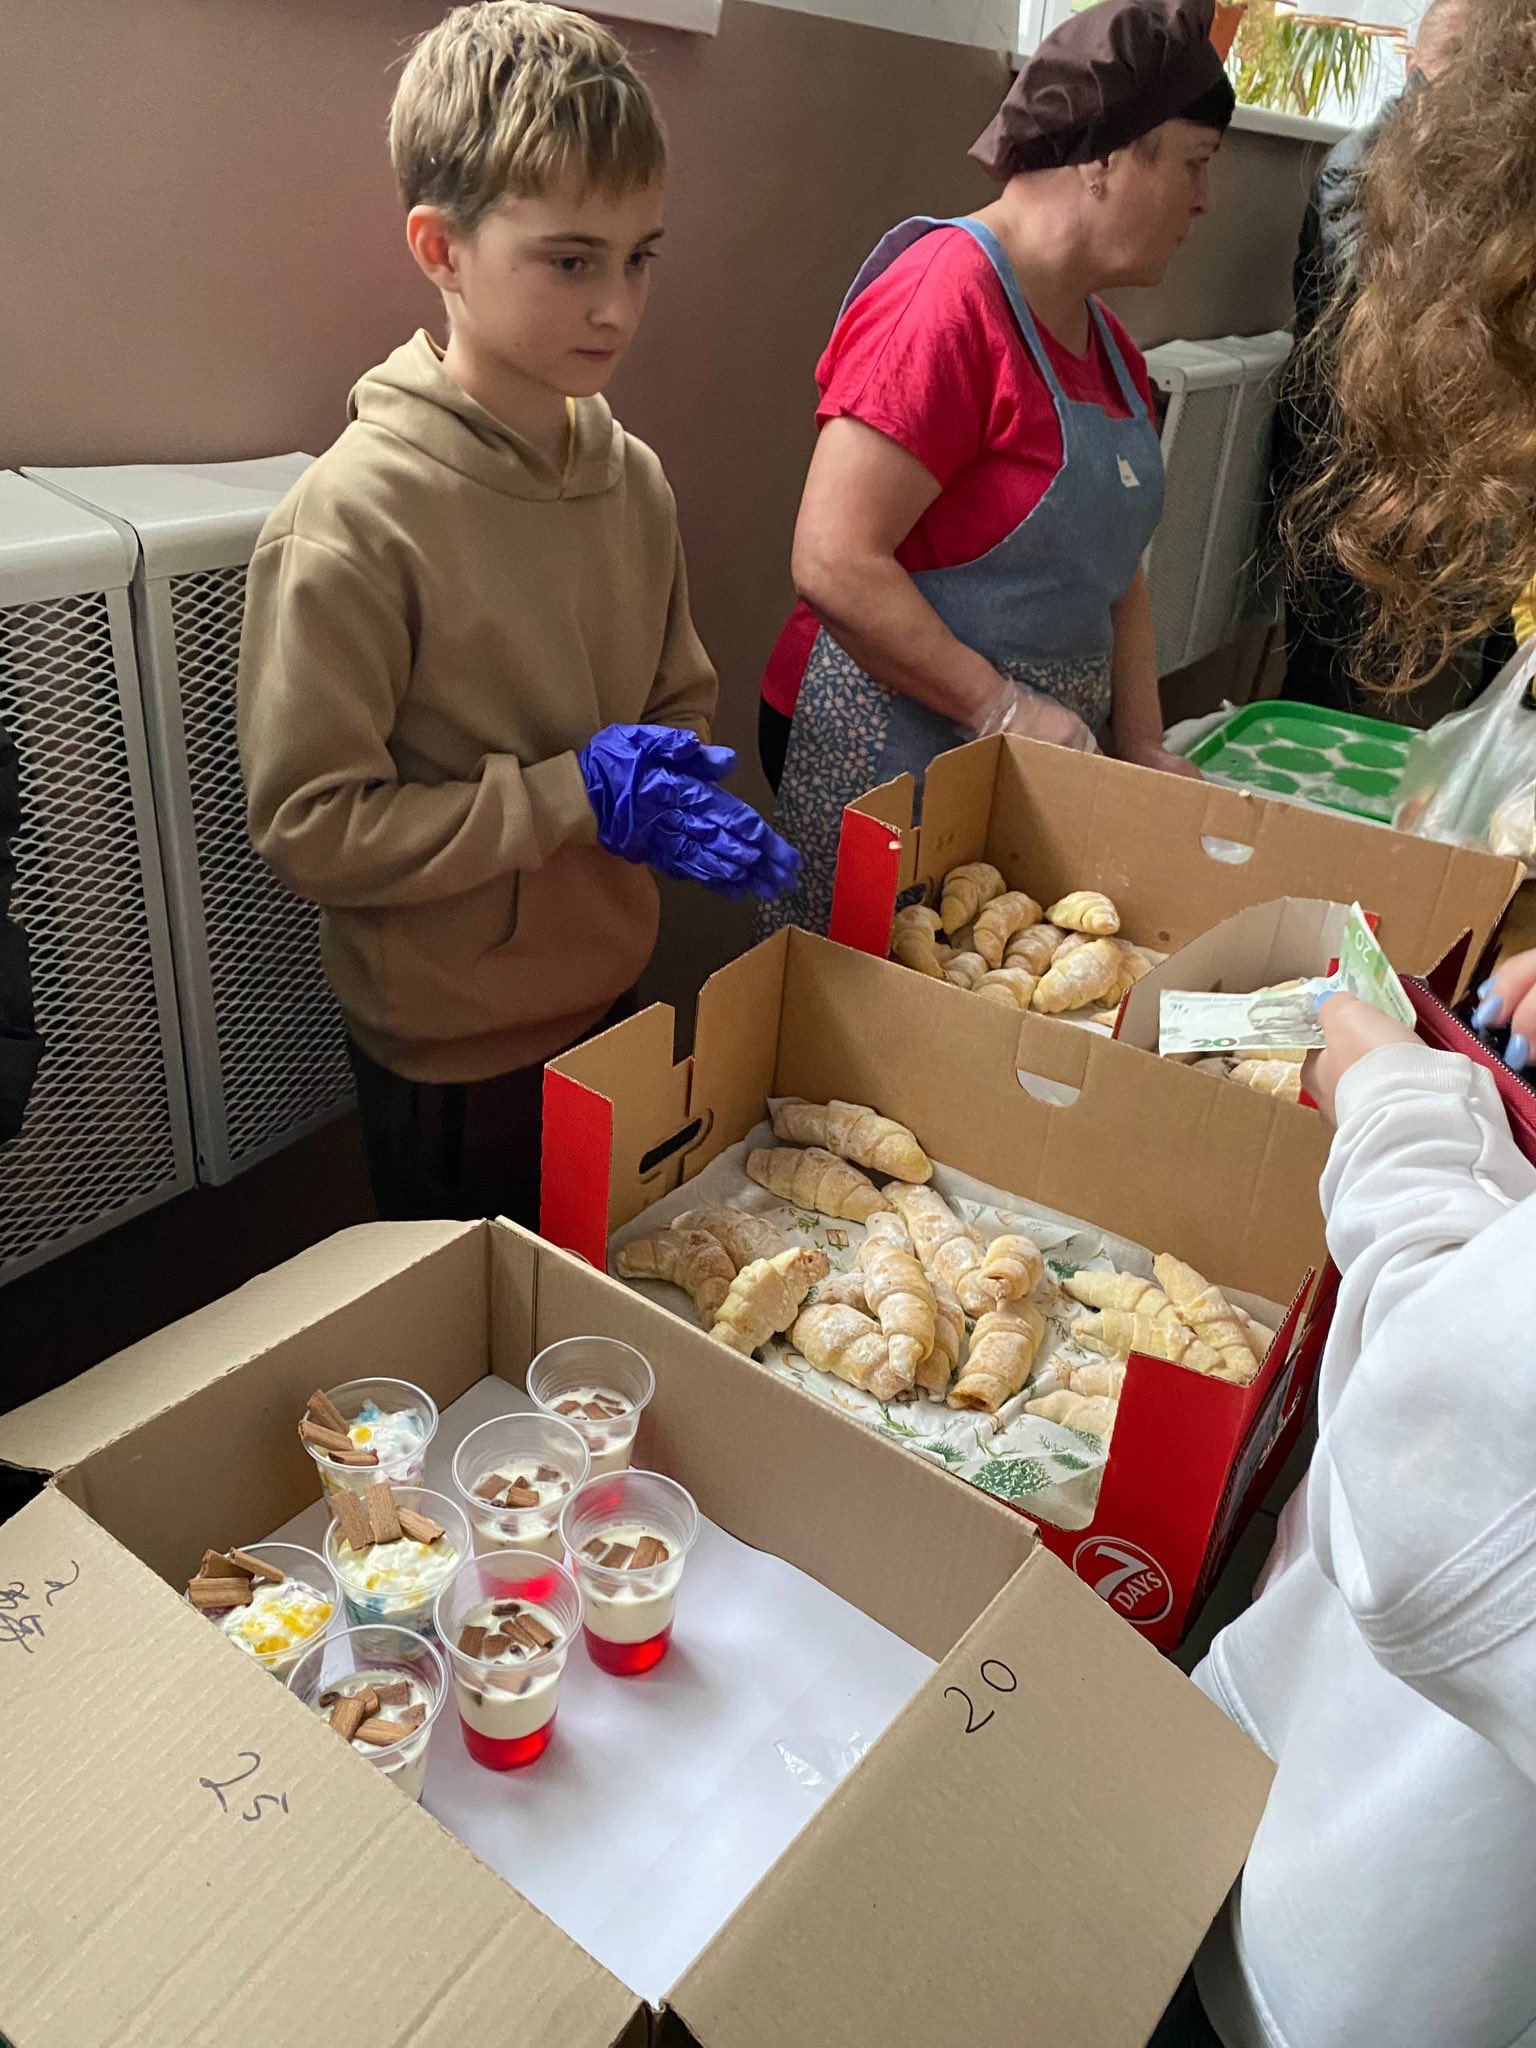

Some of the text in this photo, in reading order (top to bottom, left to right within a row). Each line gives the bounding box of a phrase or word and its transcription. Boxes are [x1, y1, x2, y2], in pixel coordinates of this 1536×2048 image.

[1355, 929, 1373, 963] 20
[1190, 1037, 1238, 1048] 20
[1094, 1544, 1162, 1611] 7 DAYS
[944, 1659, 1017, 1733] 20
[199, 1751, 289, 1822] 25
